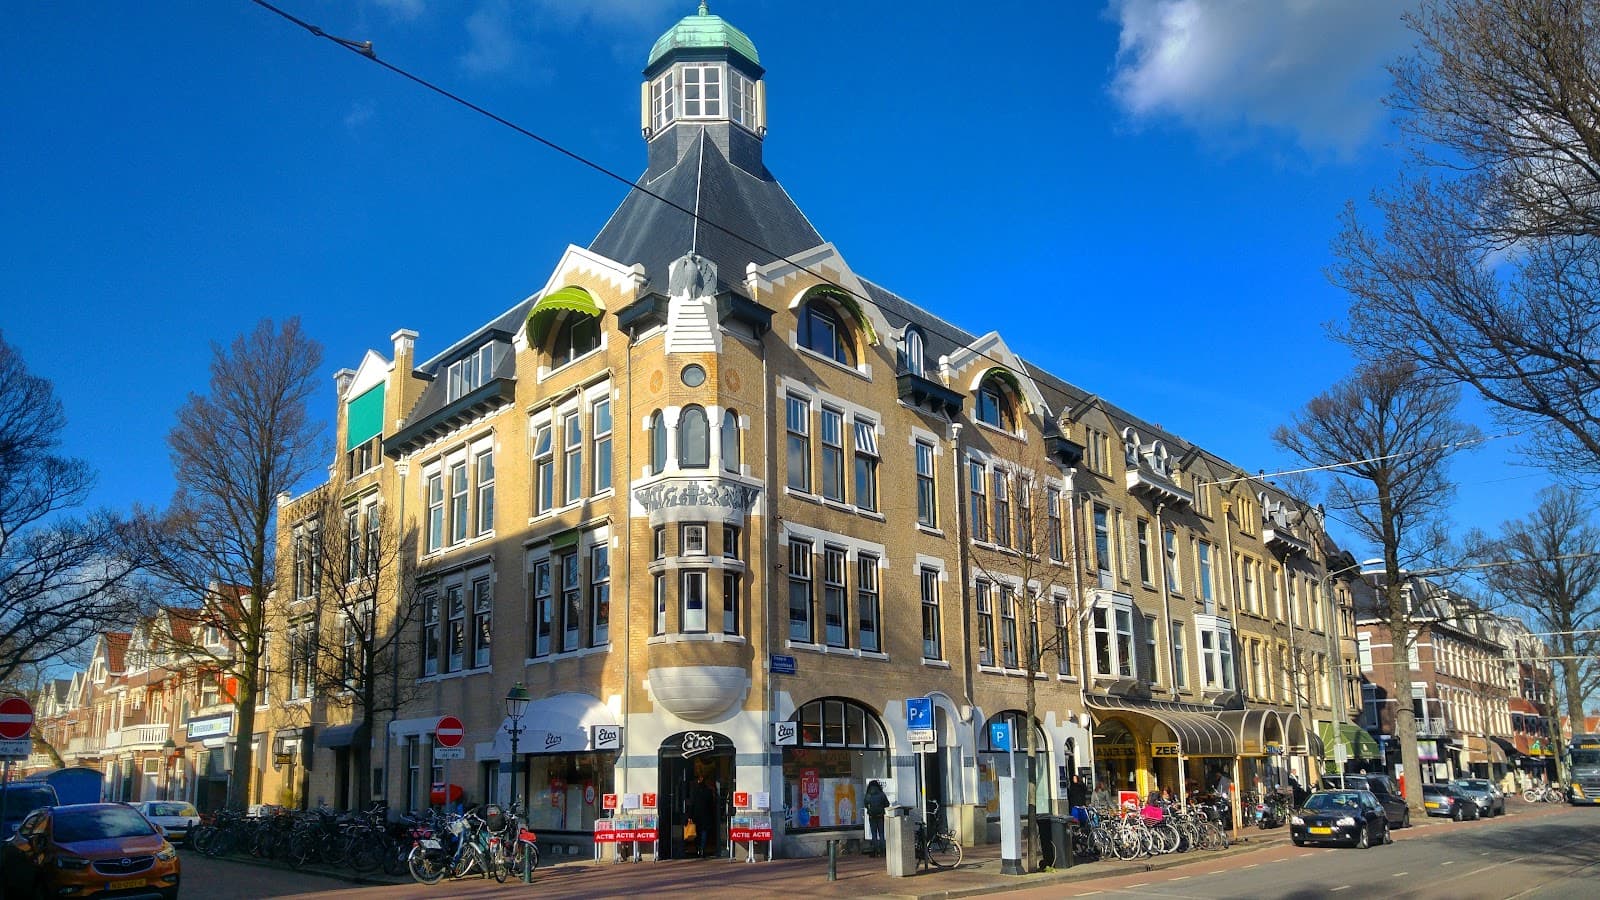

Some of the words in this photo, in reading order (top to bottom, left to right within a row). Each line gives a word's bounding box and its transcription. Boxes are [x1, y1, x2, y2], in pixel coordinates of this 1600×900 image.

[910, 708, 918, 720] P
[599, 729, 617, 742] Etos
[778, 725, 794, 738] Etos
[996, 732, 1004, 742] P
[545, 733, 562, 746] Etos
[682, 732, 714, 754] Etos
